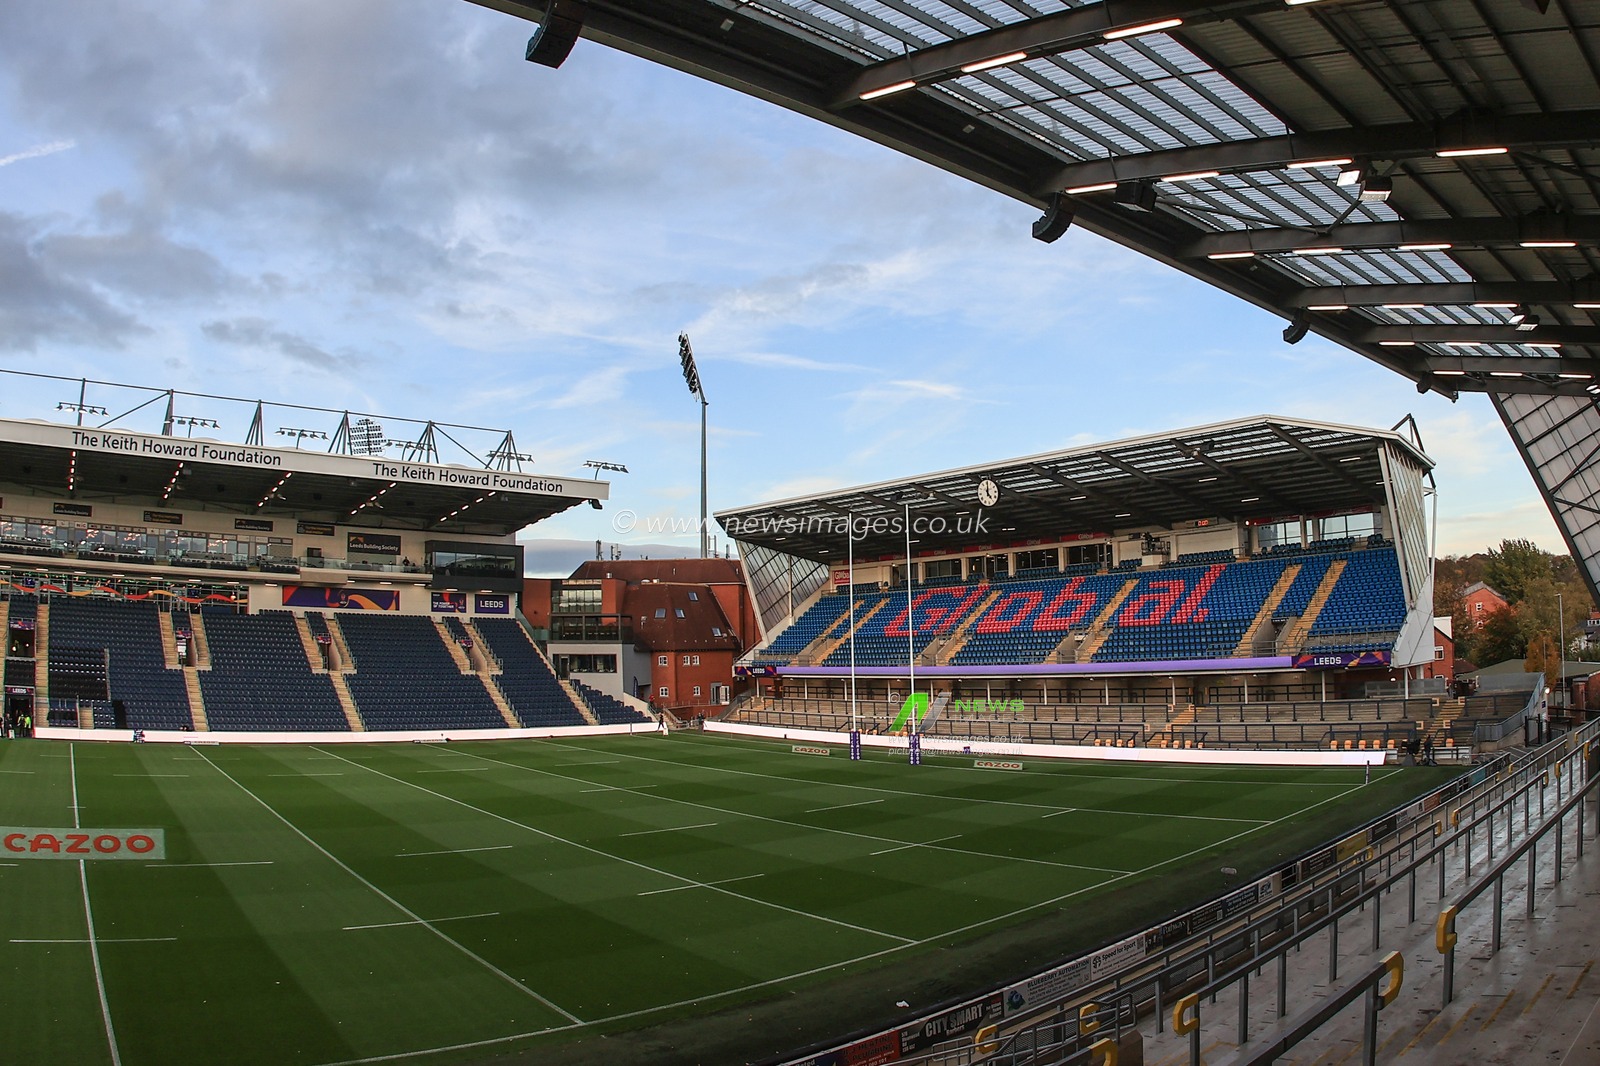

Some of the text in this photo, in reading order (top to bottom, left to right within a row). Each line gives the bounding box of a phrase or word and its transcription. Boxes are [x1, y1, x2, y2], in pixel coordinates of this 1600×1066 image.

[72, 431, 281, 466] The Keith Howard Foundation
[372, 463, 563, 493] The Keith Howard Foundation
[480, 600, 504, 608] LEEDS
[1313, 657, 1342, 665] LEEDS
[794, 747, 828, 755] CAZOO
[976, 760, 1020, 769] CAZOO
[4, 832, 155, 854] CAZOO
[1101, 949, 1117, 961] Speed
[1123, 941, 1137, 952] Sport
[1027, 973, 1058, 988] BLUEBERRY
[1058, 959, 1090, 976] AUTOMATION
[925, 1016, 948, 1038] CITY
[949, 1003, 983, 1029] SMART
